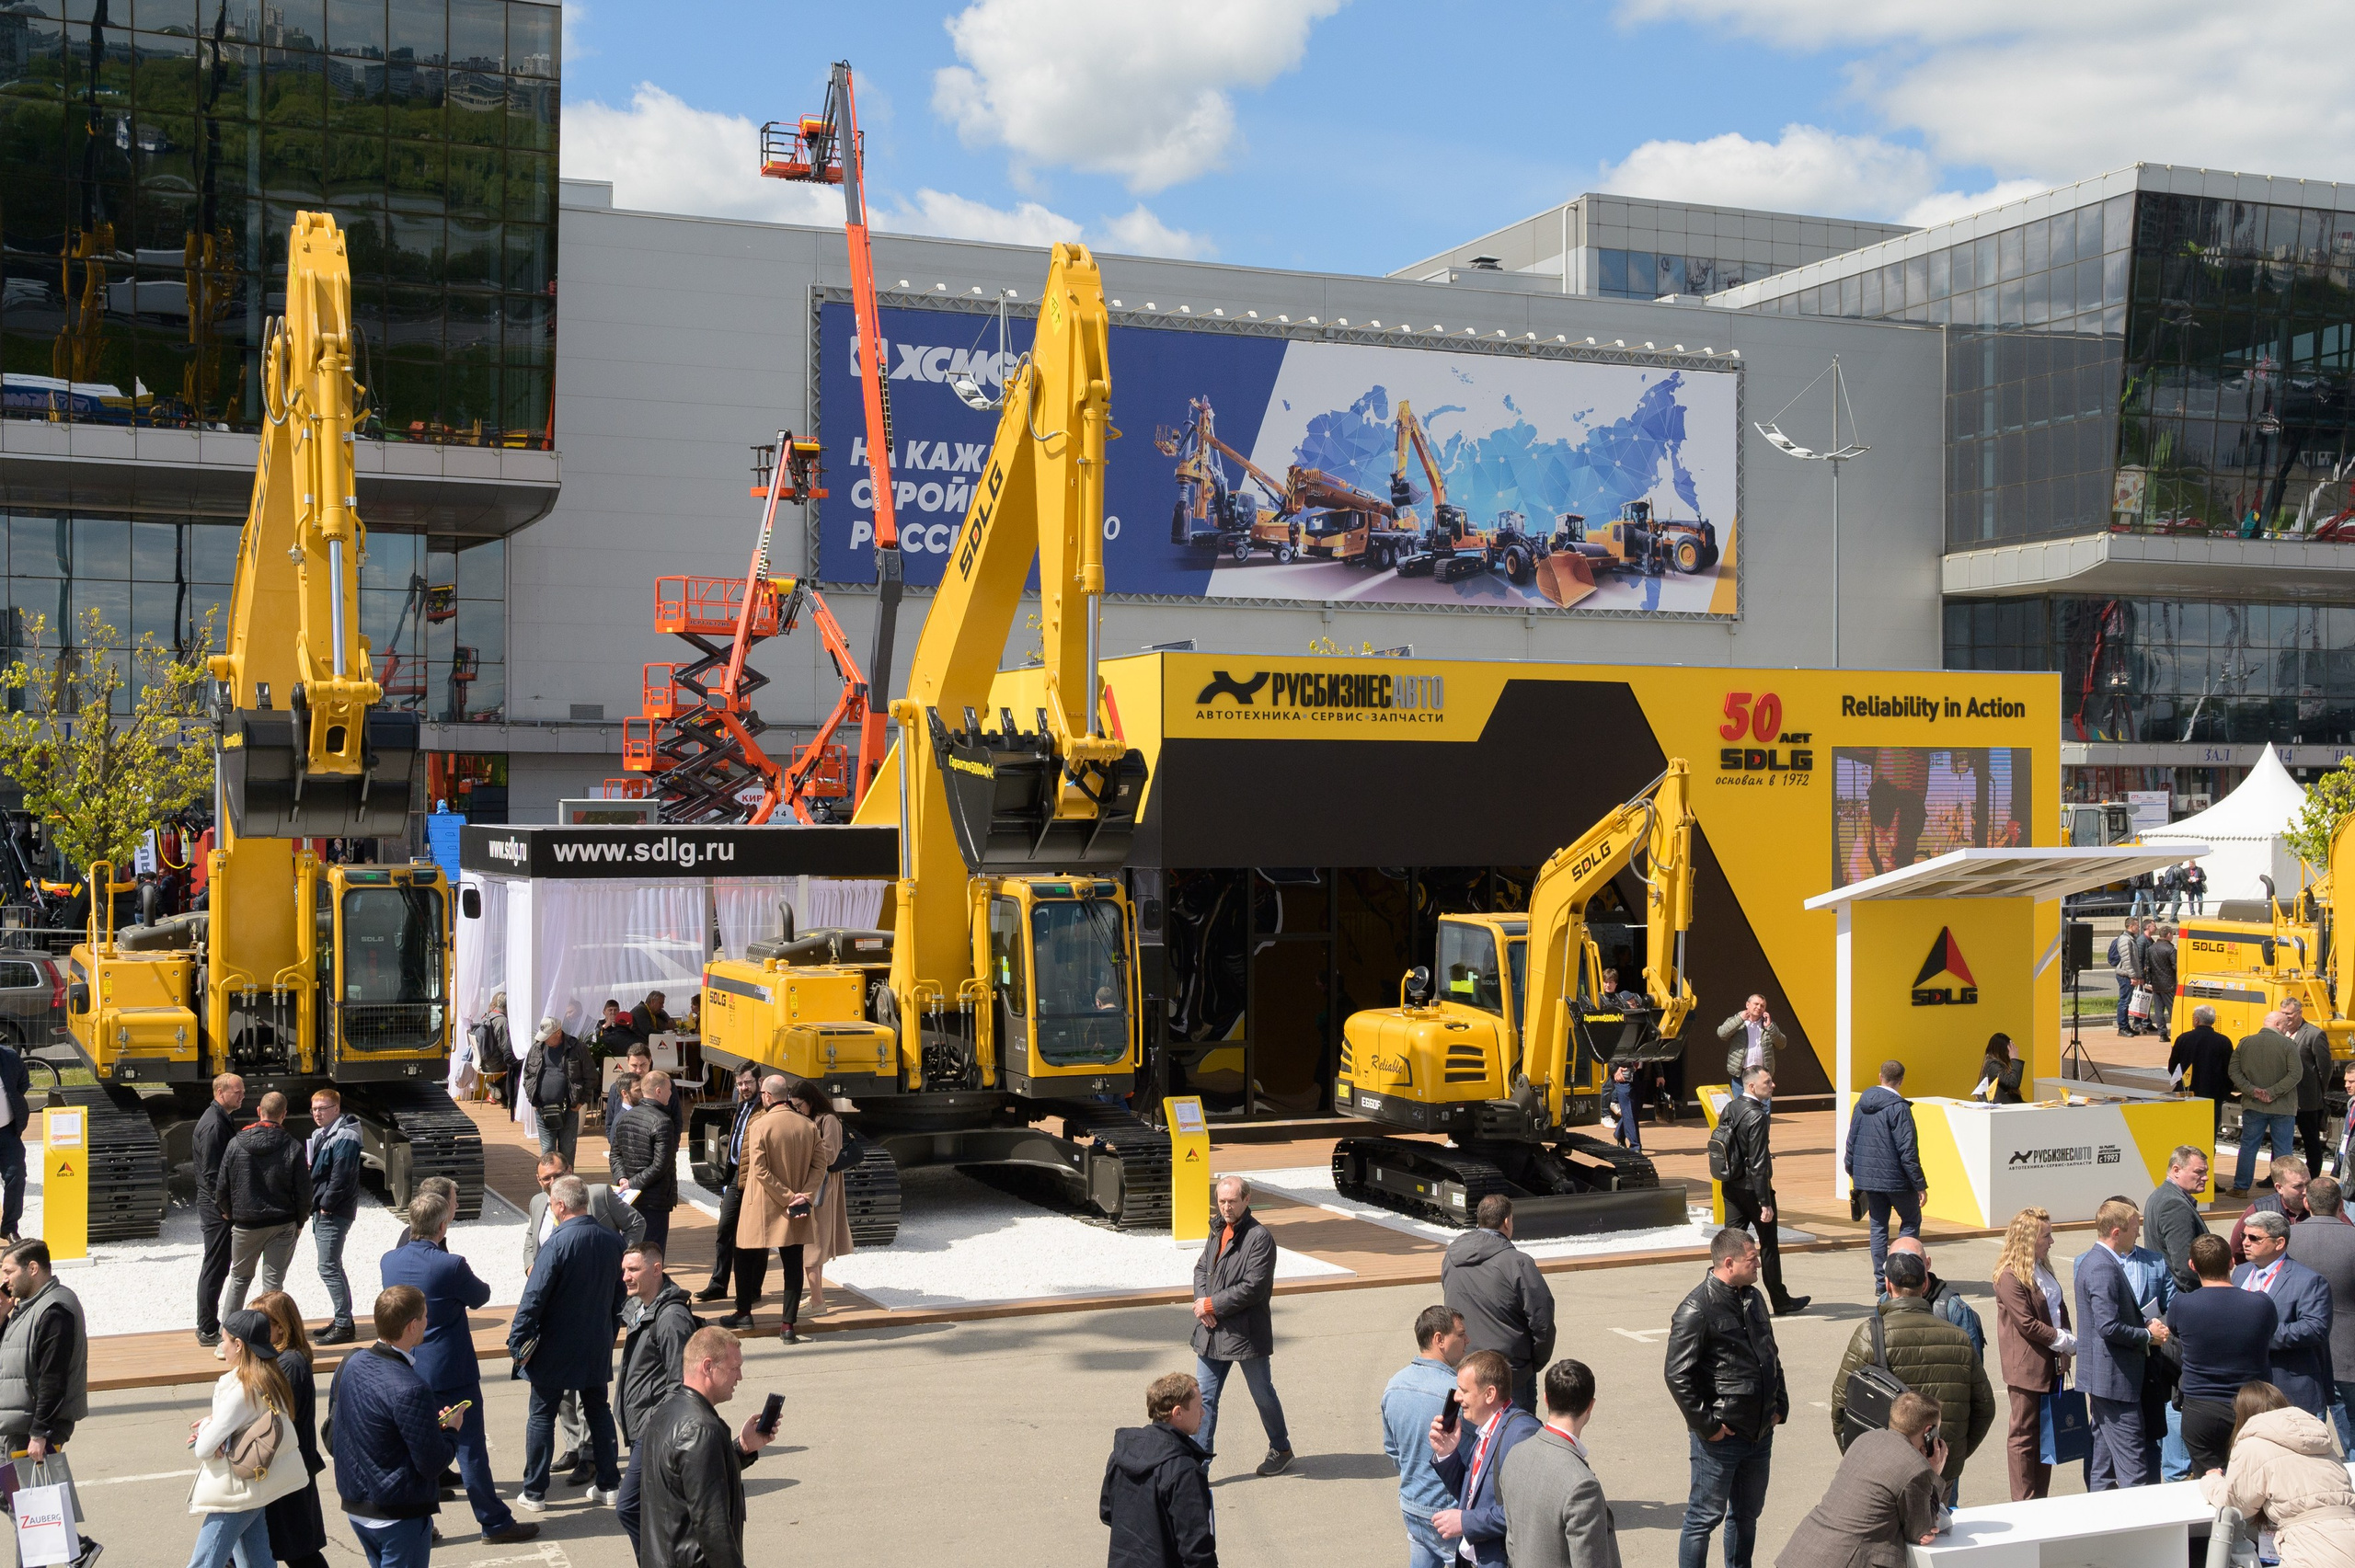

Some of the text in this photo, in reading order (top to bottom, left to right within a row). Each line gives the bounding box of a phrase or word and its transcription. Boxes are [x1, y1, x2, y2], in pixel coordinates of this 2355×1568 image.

[905, 441, 988, 474] КАЖ
[251, 431, 270, 570] SDLG
[959, 460, 1004, 582] SDLG
[1272, 672, 1444, 710] РУСБИЗНЕСАВТО
[1196, 710, 1444, 723] АВТОТЕХНИКА СЕРВИС ЗАПЧАСТИ
[1719, 692, 1783, 743] 50
[1842, 694, 2026, 723] Reliability in Action
[1720, 748, 1813, 772] SDLG
[2204, 749, 2292, 762] ЗАЛ 14
[1716, 773, 1763, 786] основан
[1782, 773, 1809, 787] 1972
[488, 836, 528, 867] www.sdlg.ru
[553, 837, 735, 867] www.sdlg.ru
[1572, 841, 1612, 883] SDLG
[2192, 941, 2225, 953] SDLG
[709, 990, 727, 1007] SDLG
[1912, 987, 1978, 1007] SDLG
[1371, 1054, 1403, 1075] Reliable
[2034, 1146, 2093, 1164] РУСБИЗНЕСАВТО
[2103, 1153, 2119, 1162] 1993
[20, 1514, 62, 1529] ZAUBERG
